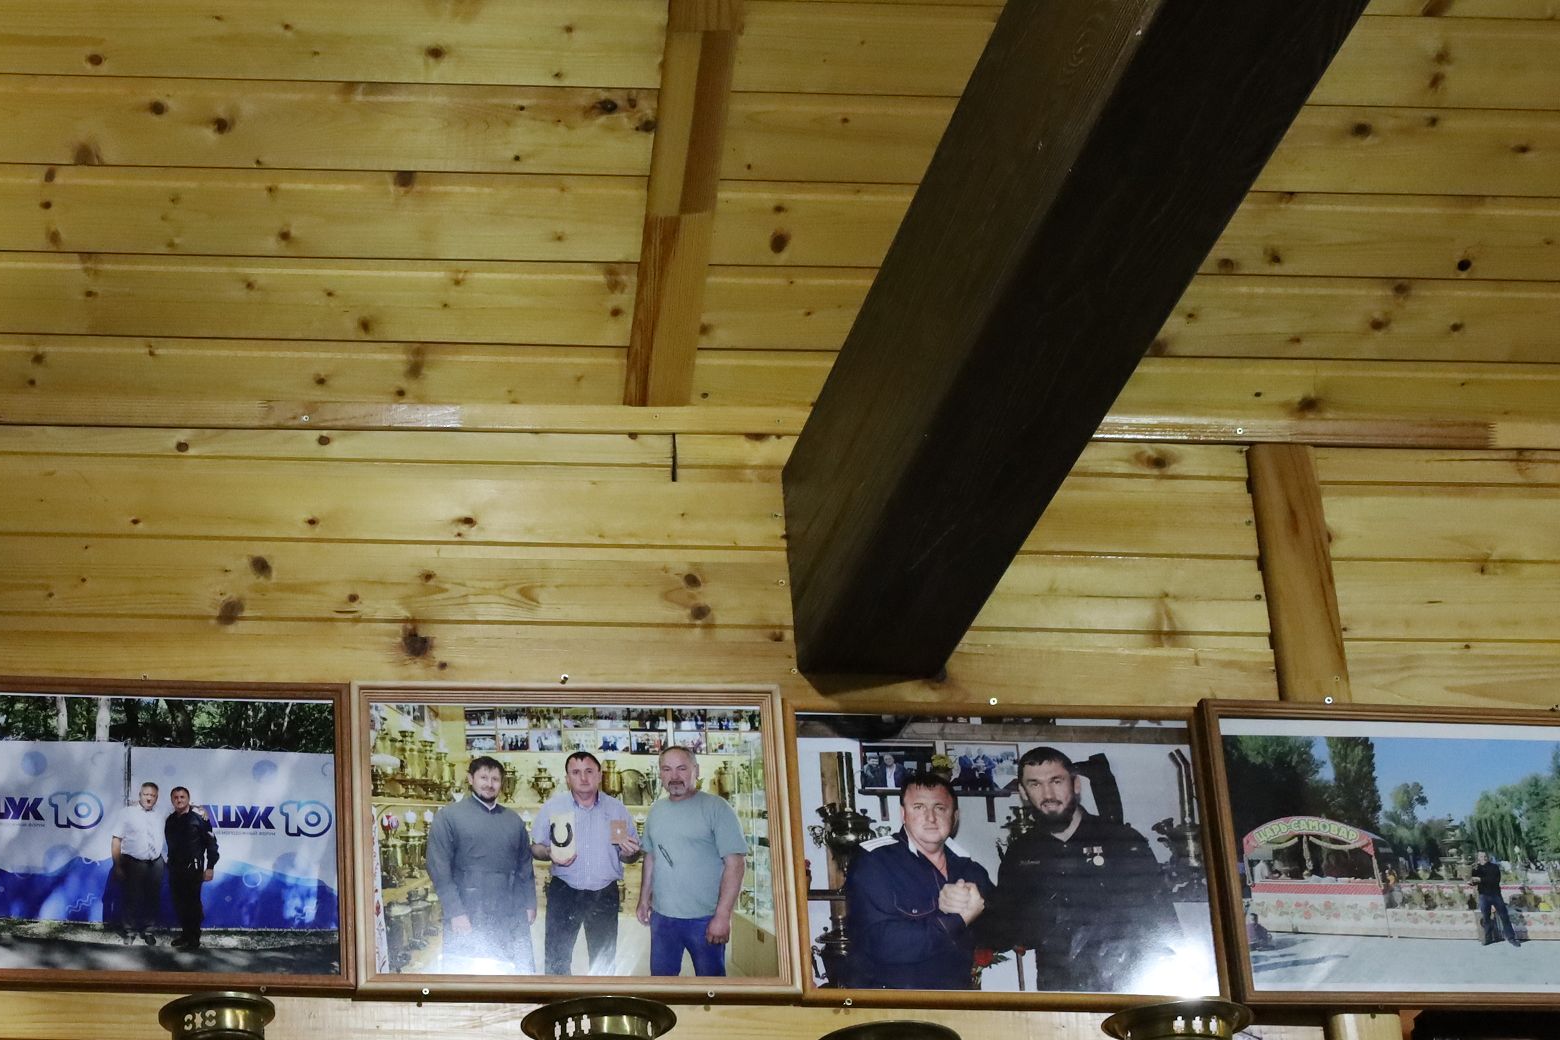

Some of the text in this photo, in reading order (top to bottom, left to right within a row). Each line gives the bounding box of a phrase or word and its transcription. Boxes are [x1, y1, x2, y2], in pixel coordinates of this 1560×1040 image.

[48, 791, 104, 829] 10
[280, 800, 332, 838] 10
[1254, 819, 1359, 842] ЦАРЬ-САМОВАР
